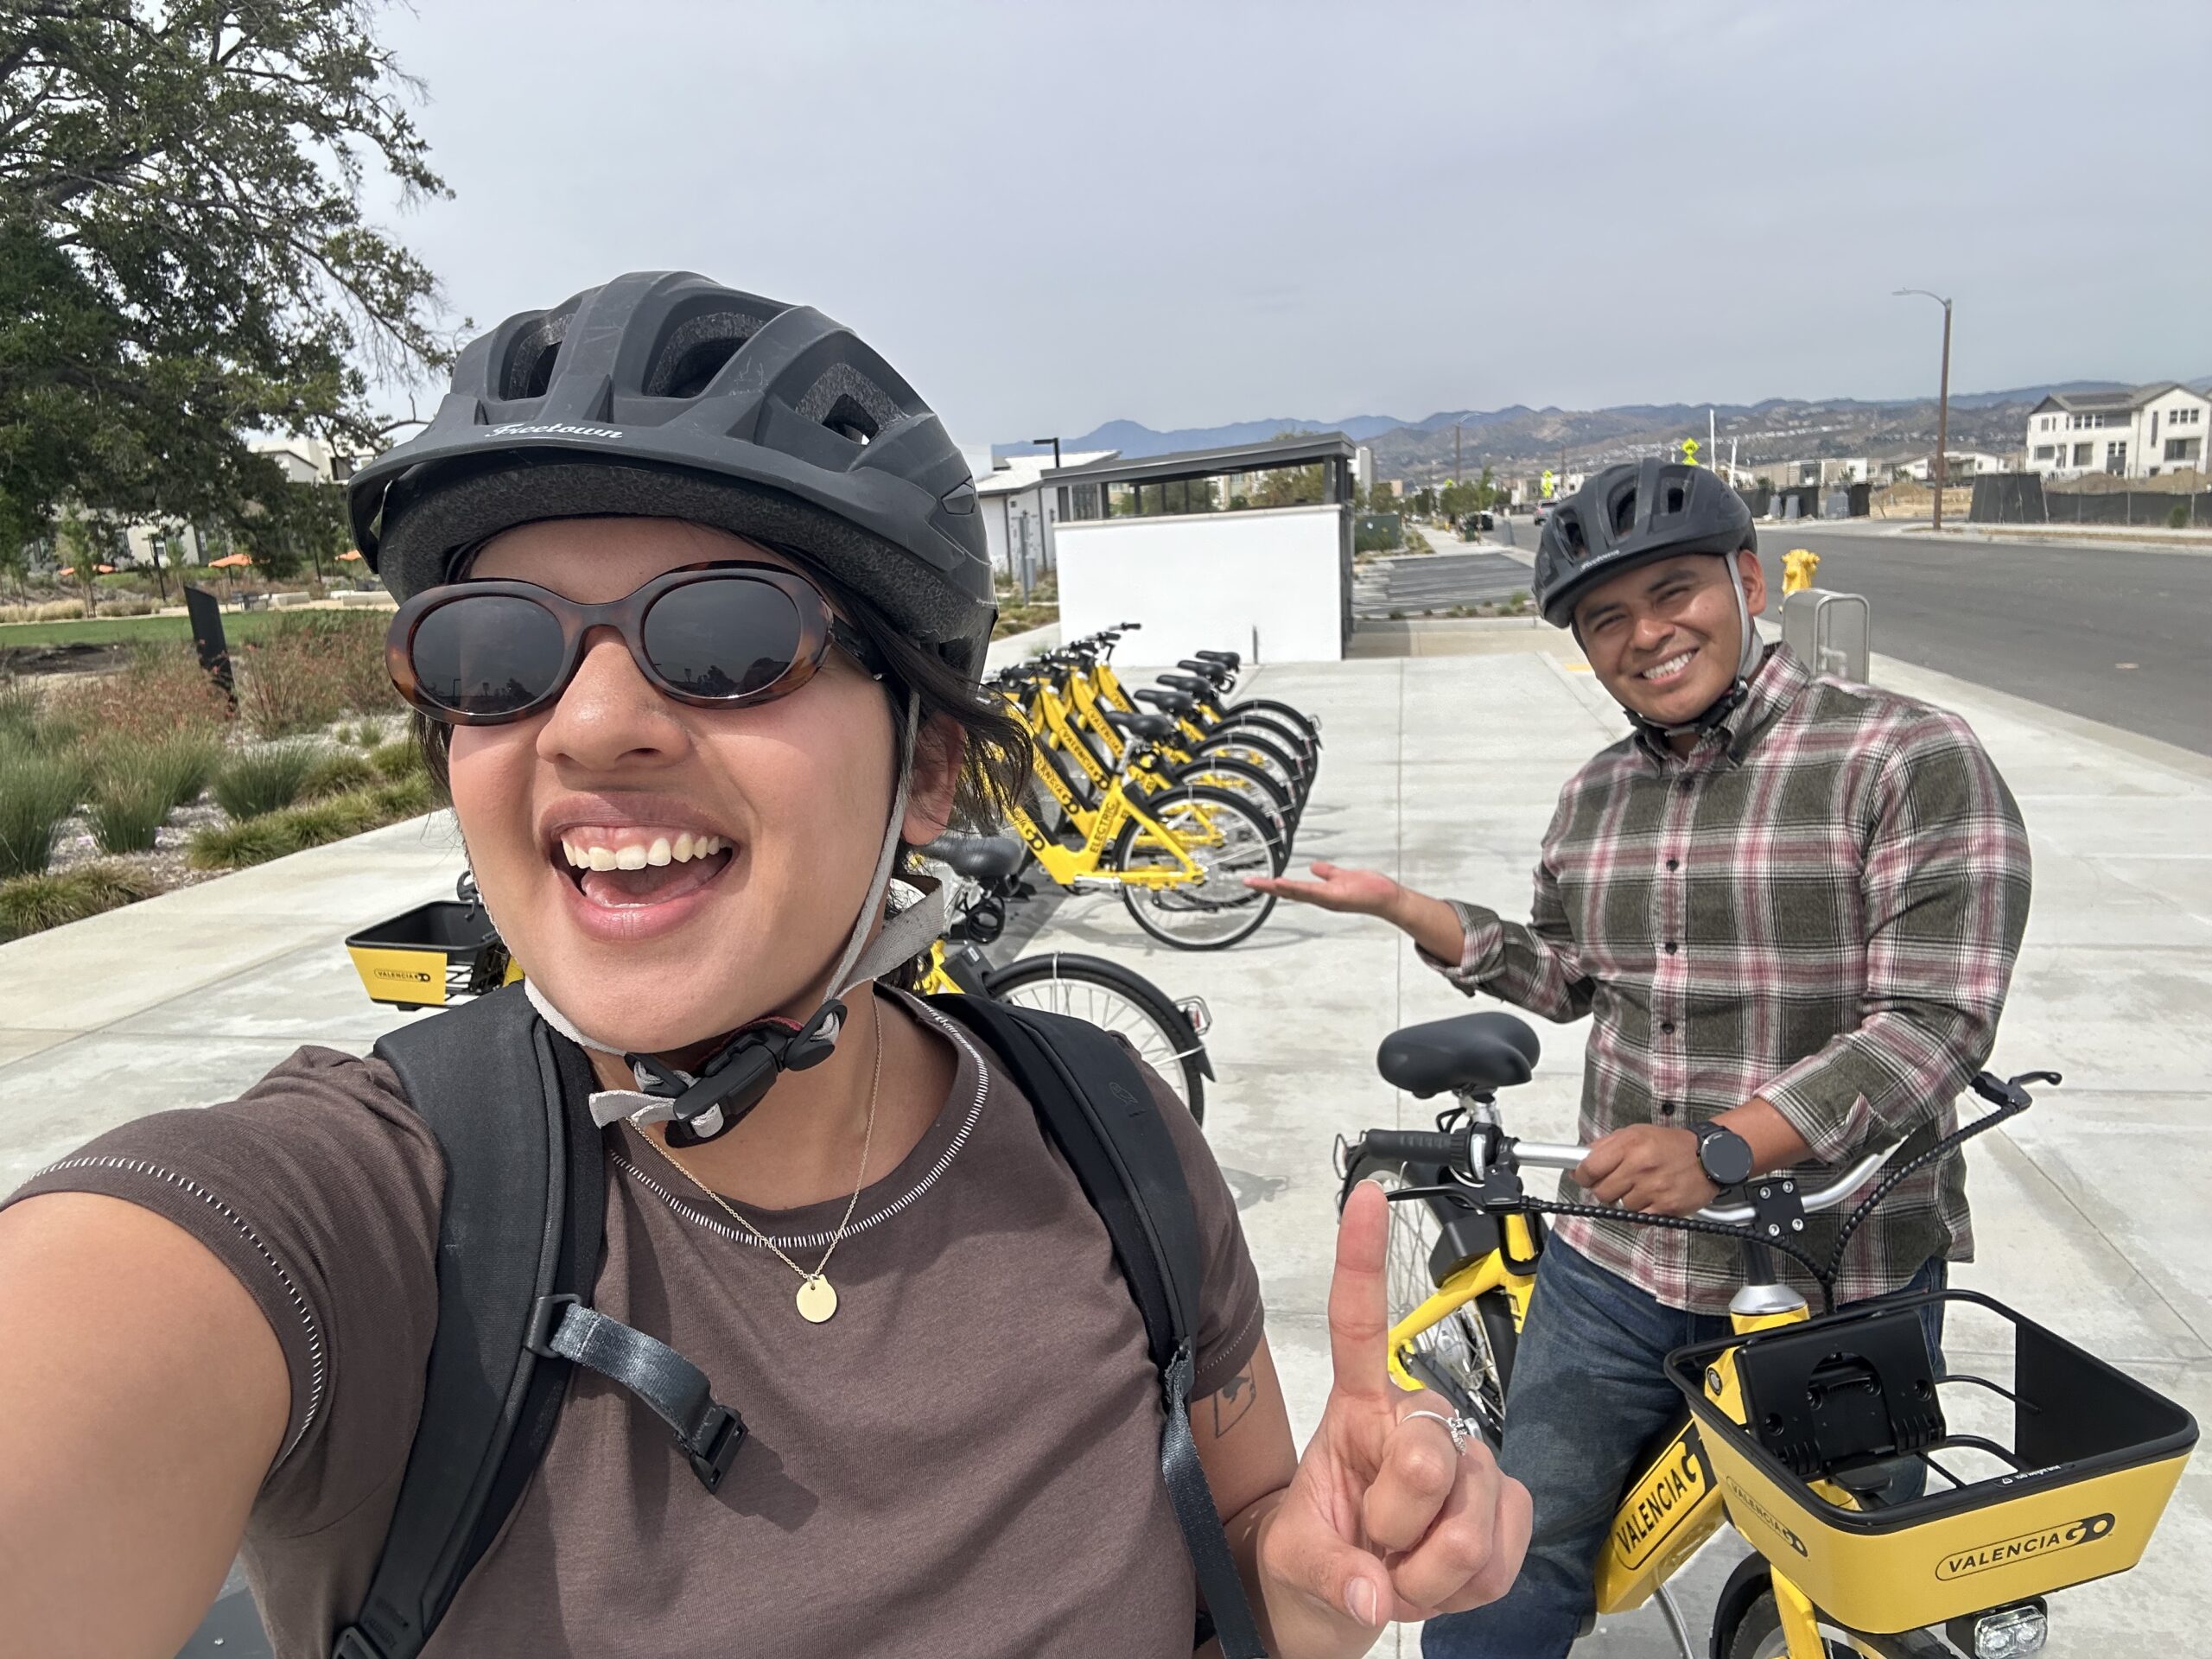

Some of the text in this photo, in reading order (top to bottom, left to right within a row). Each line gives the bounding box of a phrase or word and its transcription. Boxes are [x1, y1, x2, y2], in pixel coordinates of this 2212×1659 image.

[485, 423, 622, 438] Freetown
[1063, 731, 1096, 771] VALENCIA
[1090, 800, 1116, 854] ELECTRIC
[378, 971, 413, 980] VALENCIA
[1616, 1468, 1688, 1554] VALENCIA
[1731, 1481, 1781, 1530] VALENCIA
[1949, 1512, 2115, 1573] VALENCIA GO
